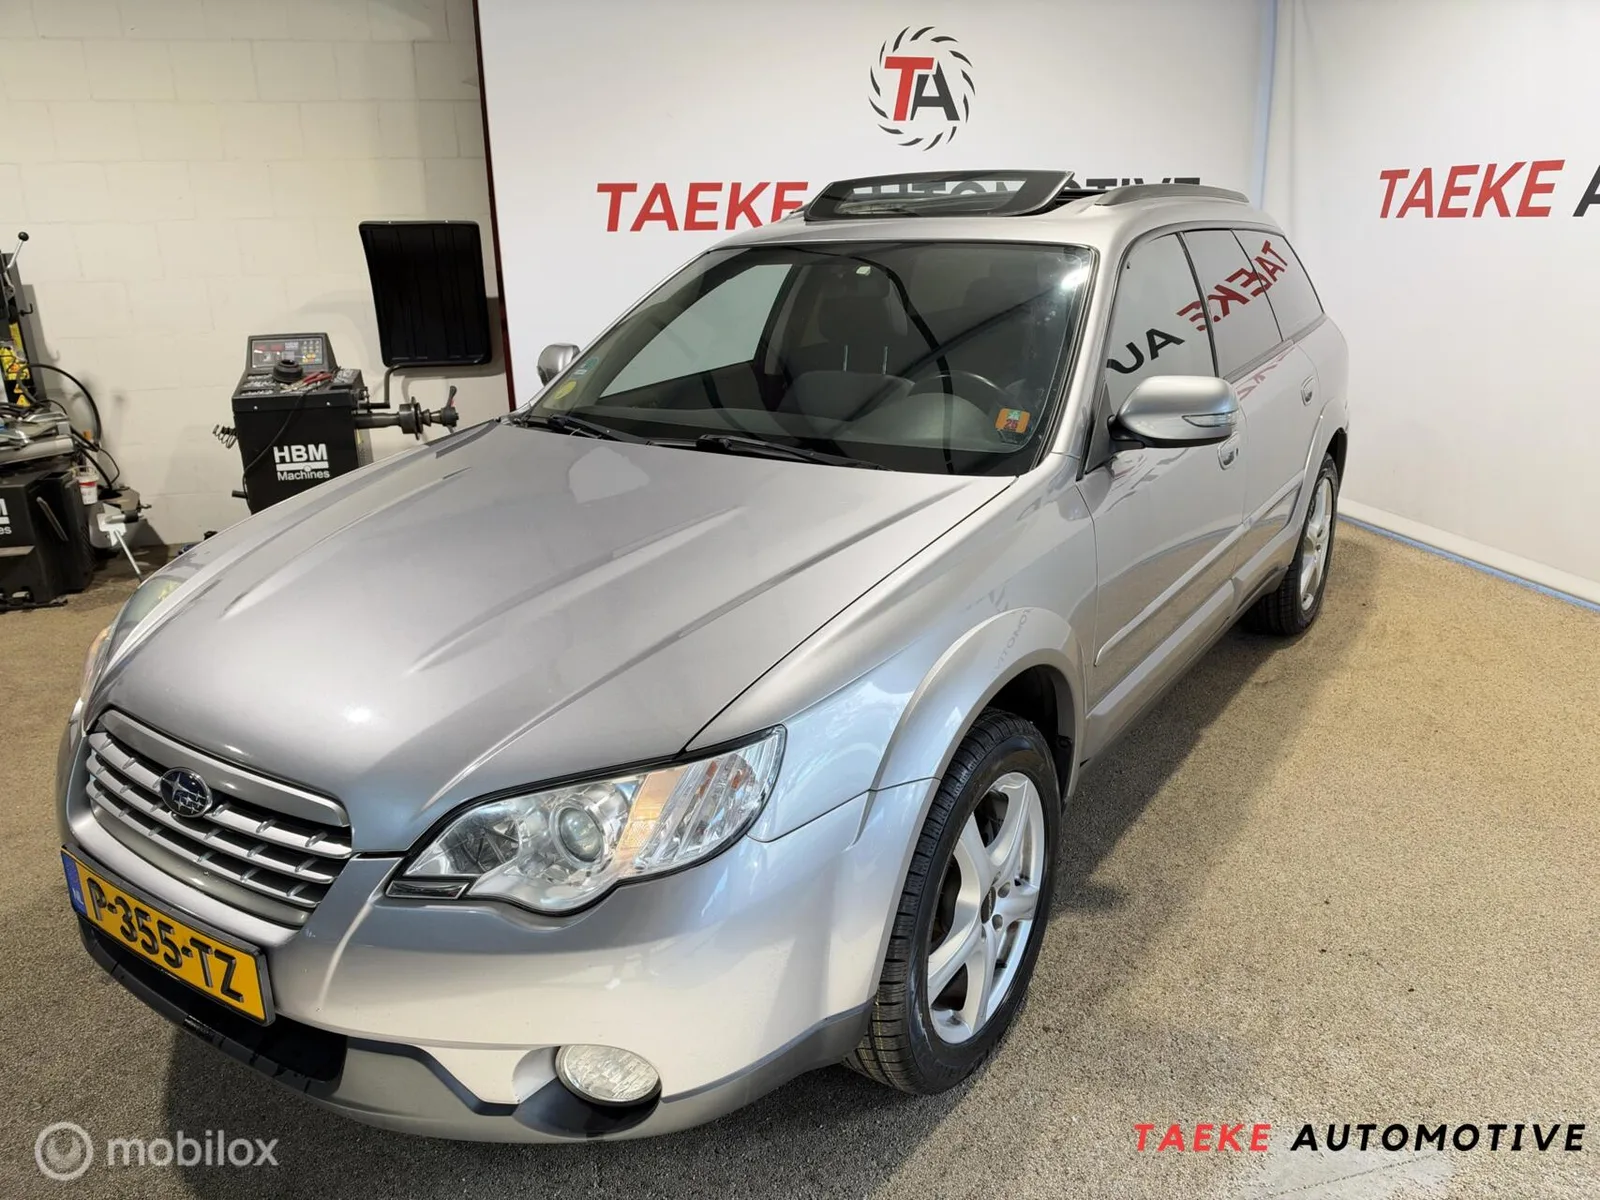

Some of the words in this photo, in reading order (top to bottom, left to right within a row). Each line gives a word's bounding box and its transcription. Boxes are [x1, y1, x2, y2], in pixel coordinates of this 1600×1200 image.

[884, 56, 960, 121] TA
[1379, 159, 1566, 218] TAEKE
[273, 443, 328, 463] HBM
[277, 470, 331, 481] Machines
[87, 877, 244, 1003] P-355-TZ
